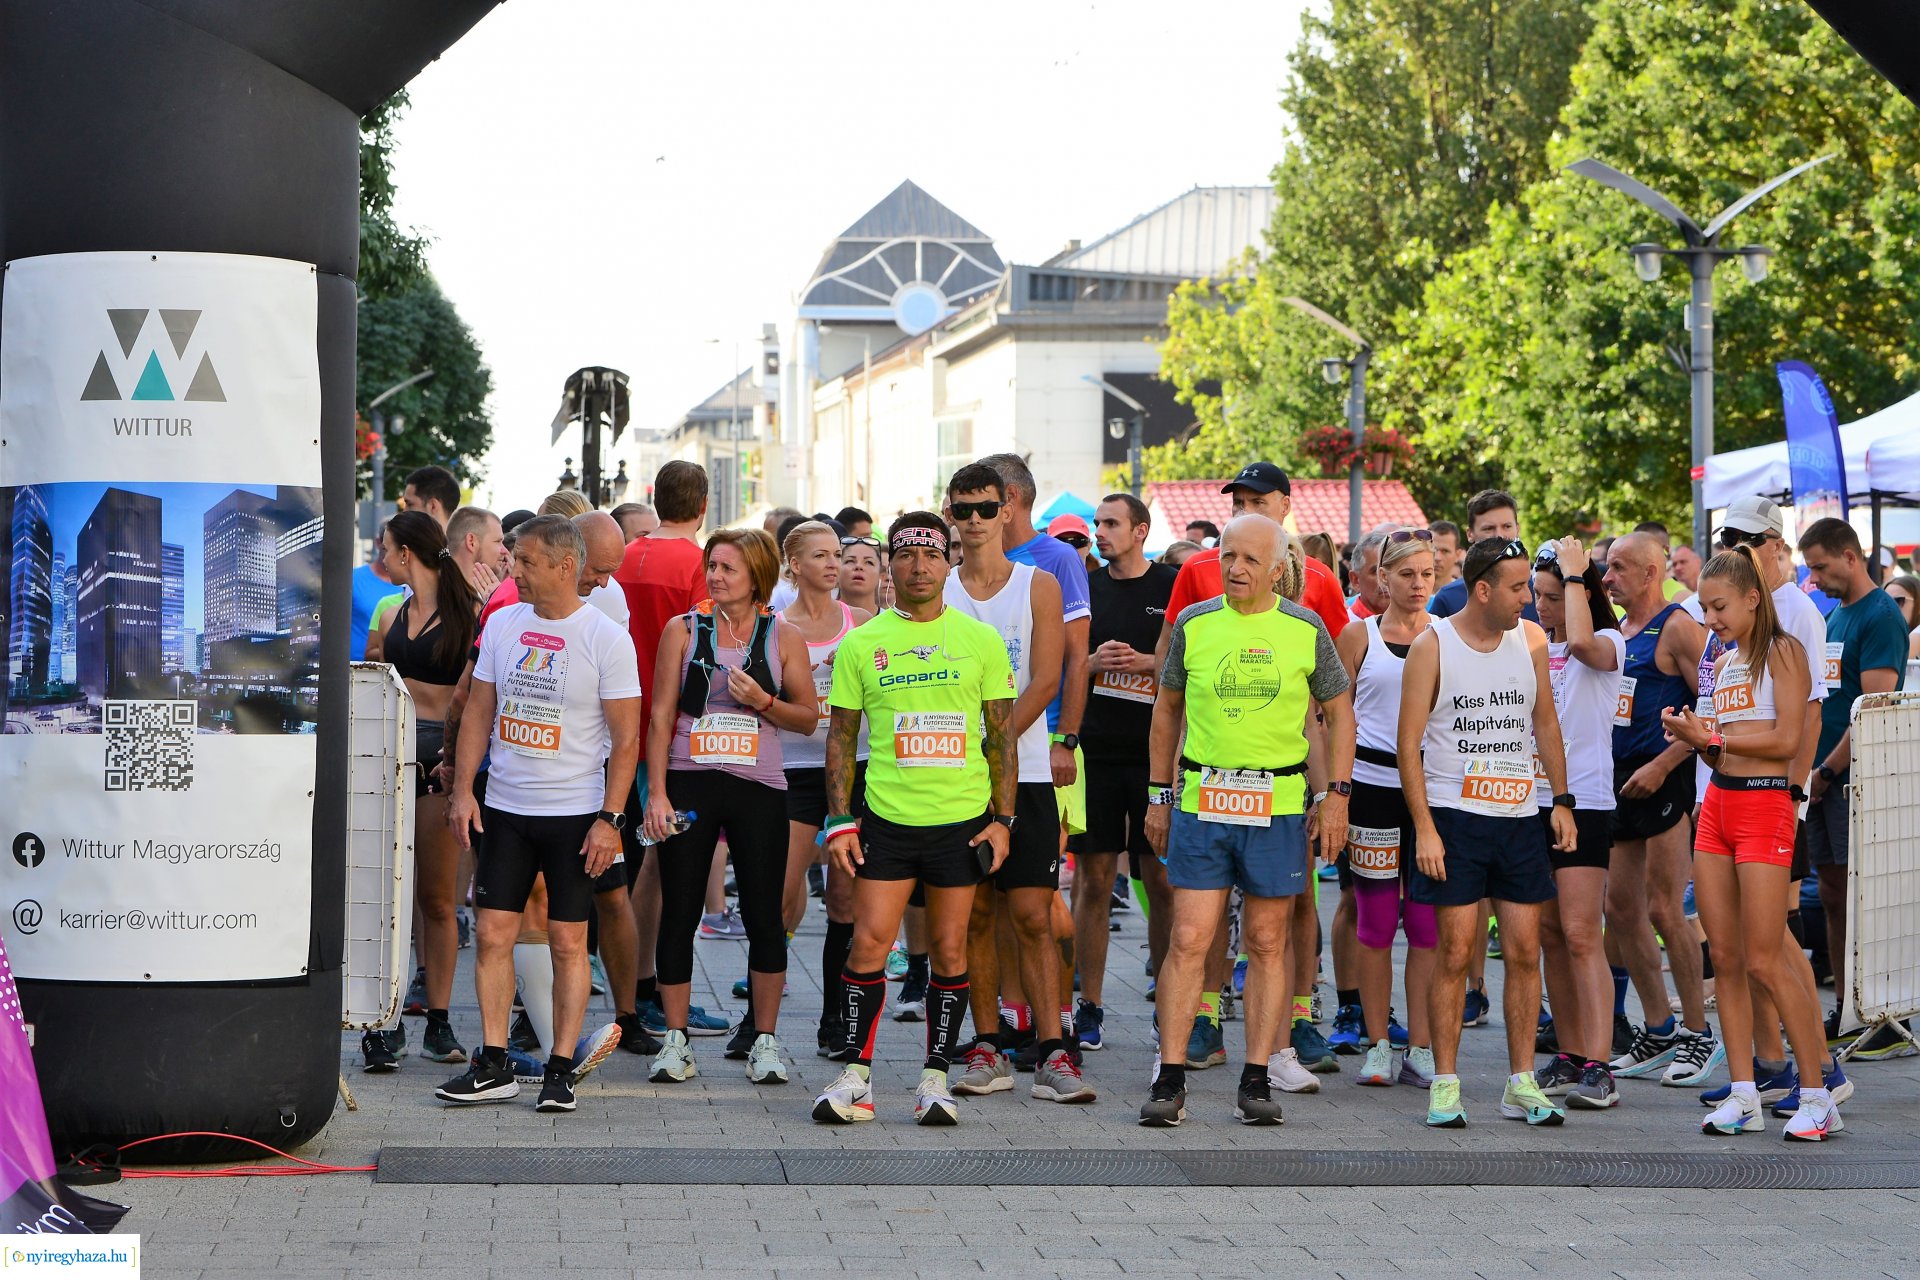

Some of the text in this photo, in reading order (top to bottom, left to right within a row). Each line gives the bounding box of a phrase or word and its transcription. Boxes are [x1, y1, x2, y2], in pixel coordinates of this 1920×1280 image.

[113, 418, 193, 437] WITTUR
[506, 677, 557, 692] FUTÓFESZTIVÁL
[514, 671, 559, 685] NYÍREGYHÁZI
[879, 669, 948, 687] Gepard
[1102, 671, 1154, 693] 10022
[1452, 689, 1525, 710] Kiss Attila
[1714, 687, 1748, 712] 10145
[503, 720, 555, 747] 10006
[1452, 715, 1525, 735] Alapítvány
[696, 735, 753, 754] 10015
[900, 735, 961, 755] 10040
[1457, 739, 1523, 754] Szerencs
[1470, 780, 1528, 801] 10058
[1746, 779, 1786, 787] NIKE PRO
[1205, 791, 1264, 814] 10001
[61, 838, 282, 864] Wittur Magyarország
[1350, 845, 1397, 867] 10084
[59, 907, 258, 930] karrier@wittur.com
[846, 984, 865, 1044] kalenji
[932, 990, 958, 1054] kalenji
